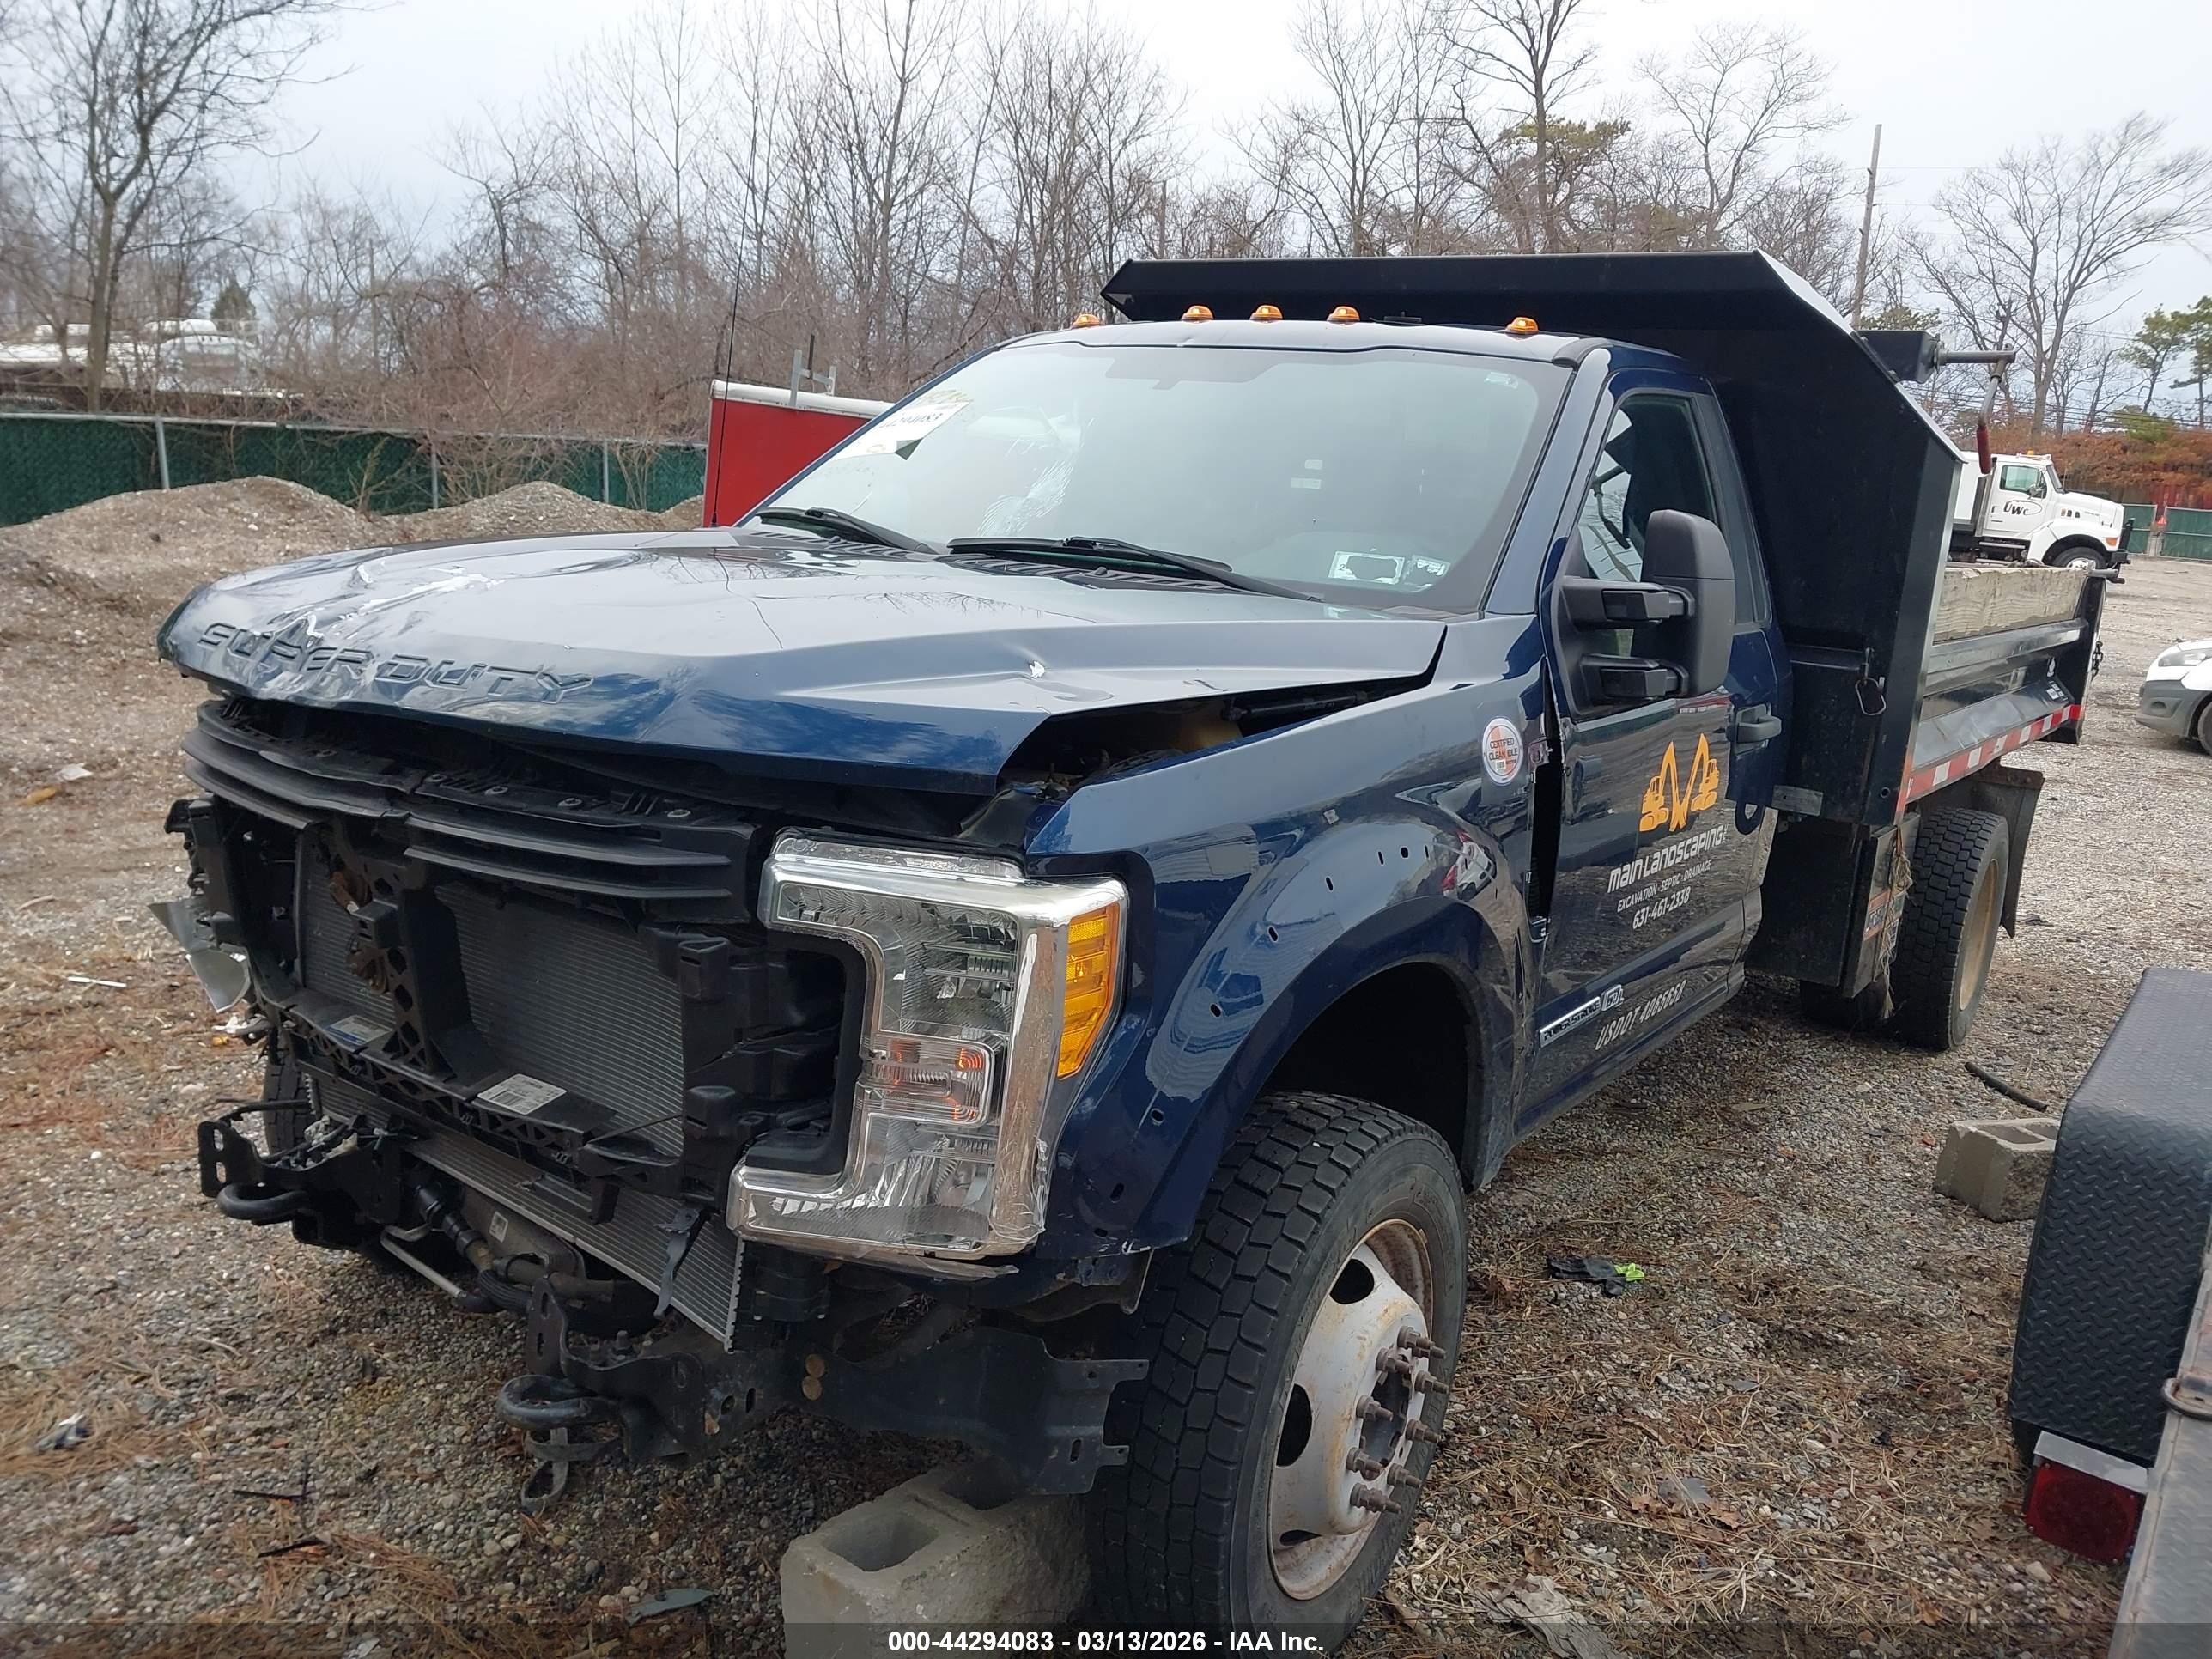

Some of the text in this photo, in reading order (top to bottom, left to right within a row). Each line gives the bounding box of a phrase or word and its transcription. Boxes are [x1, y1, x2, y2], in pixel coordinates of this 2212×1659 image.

[198, 622, 592, 705] SUPER DUTY
[1489, 747, 1518, 761] CLEAN IDLE
[1490, 738, 1514, 749] CERTIFIED
[1617, 858, 1713, 913] EXCAVATION SEPTIC DRAINAGE
[1595, 1006, 1641, 1051] USDOT
